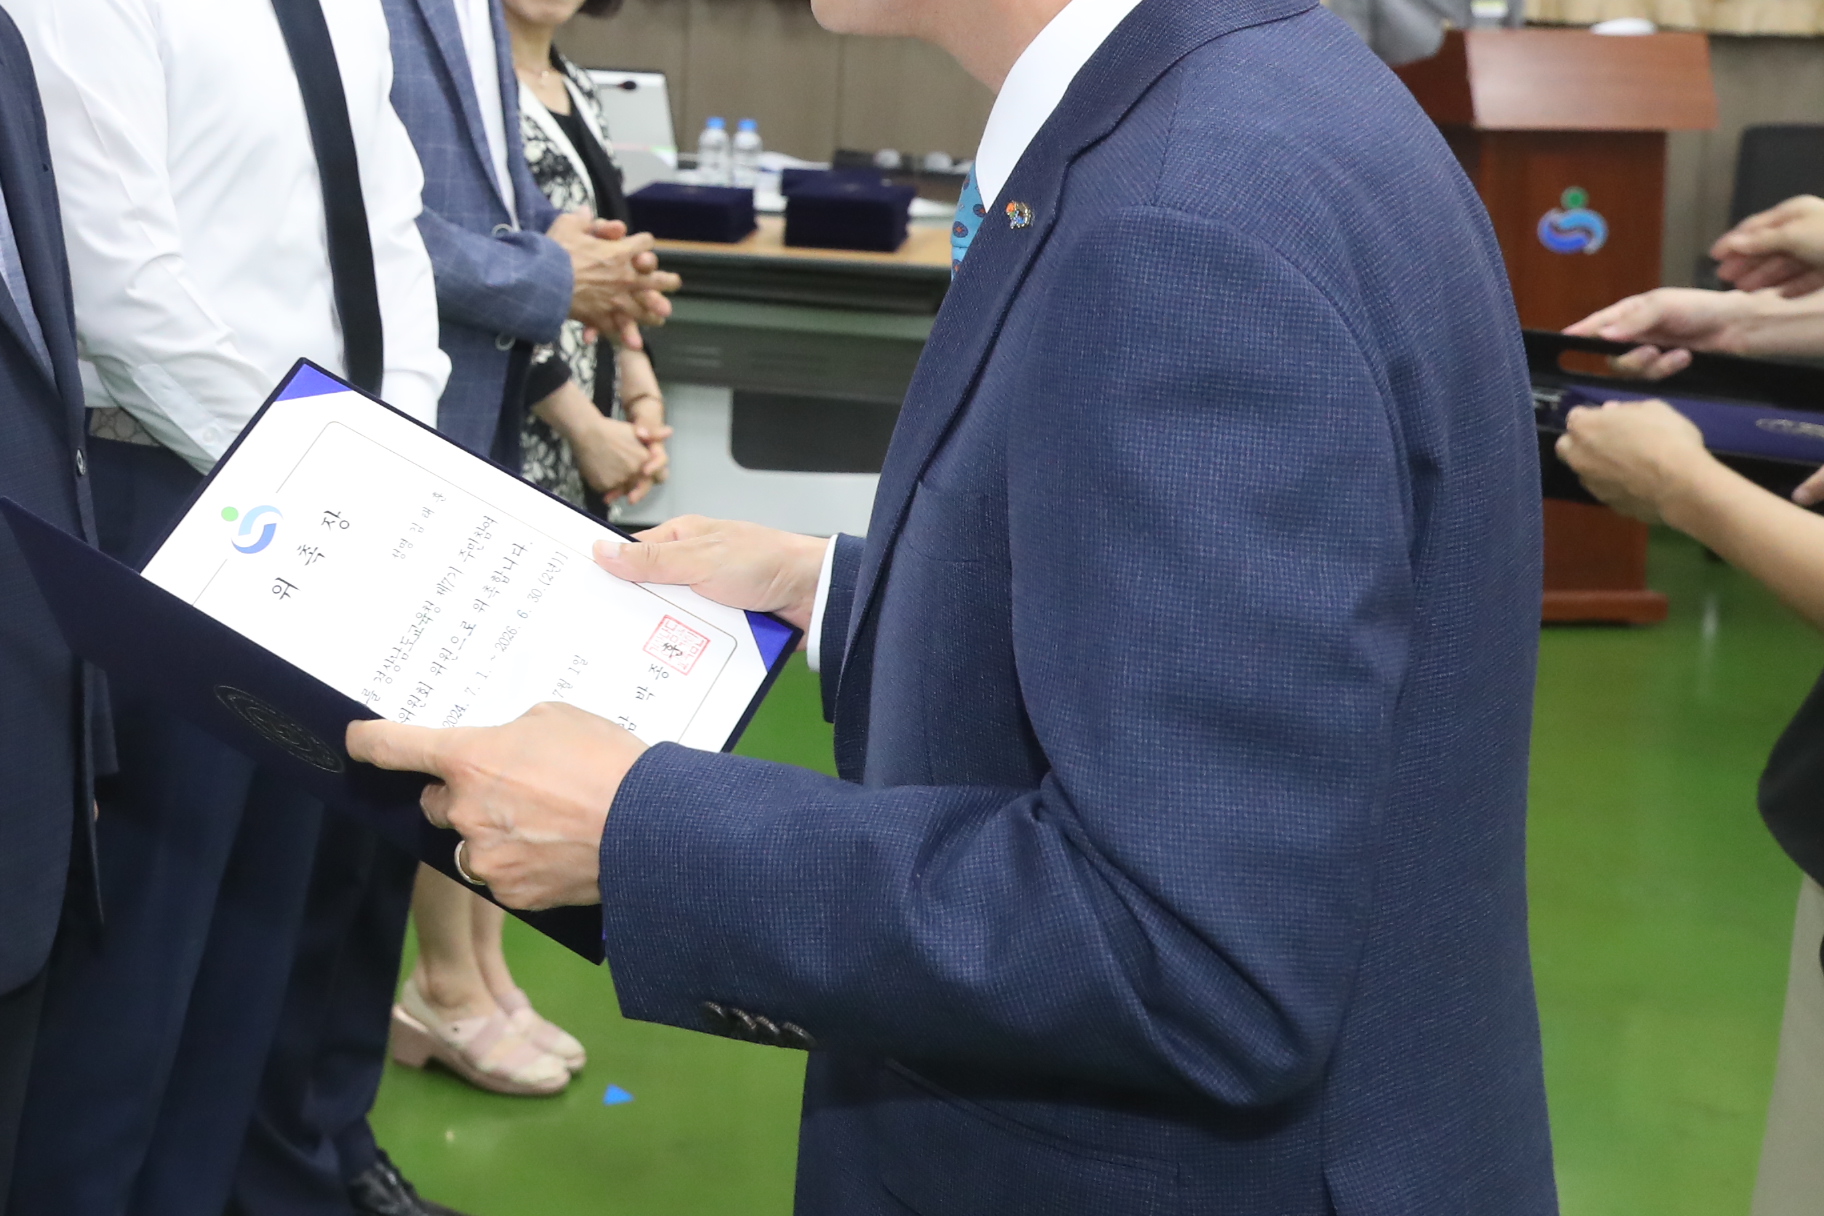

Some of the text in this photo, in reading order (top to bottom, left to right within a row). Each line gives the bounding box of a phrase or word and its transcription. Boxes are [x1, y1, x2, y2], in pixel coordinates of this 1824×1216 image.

[374, 601, 440, 684] 경상남도교육청
[437, 566, 463, 595] 제7기
[460, 516, 497, 562] 주민참여
[430, 621, 476, 675] 위원으로
[473, 543, 532, 612] 위촉합니다.
[495, 626, 520, 652] 2026.
[553, 655, 588, 698] 7월 1일
